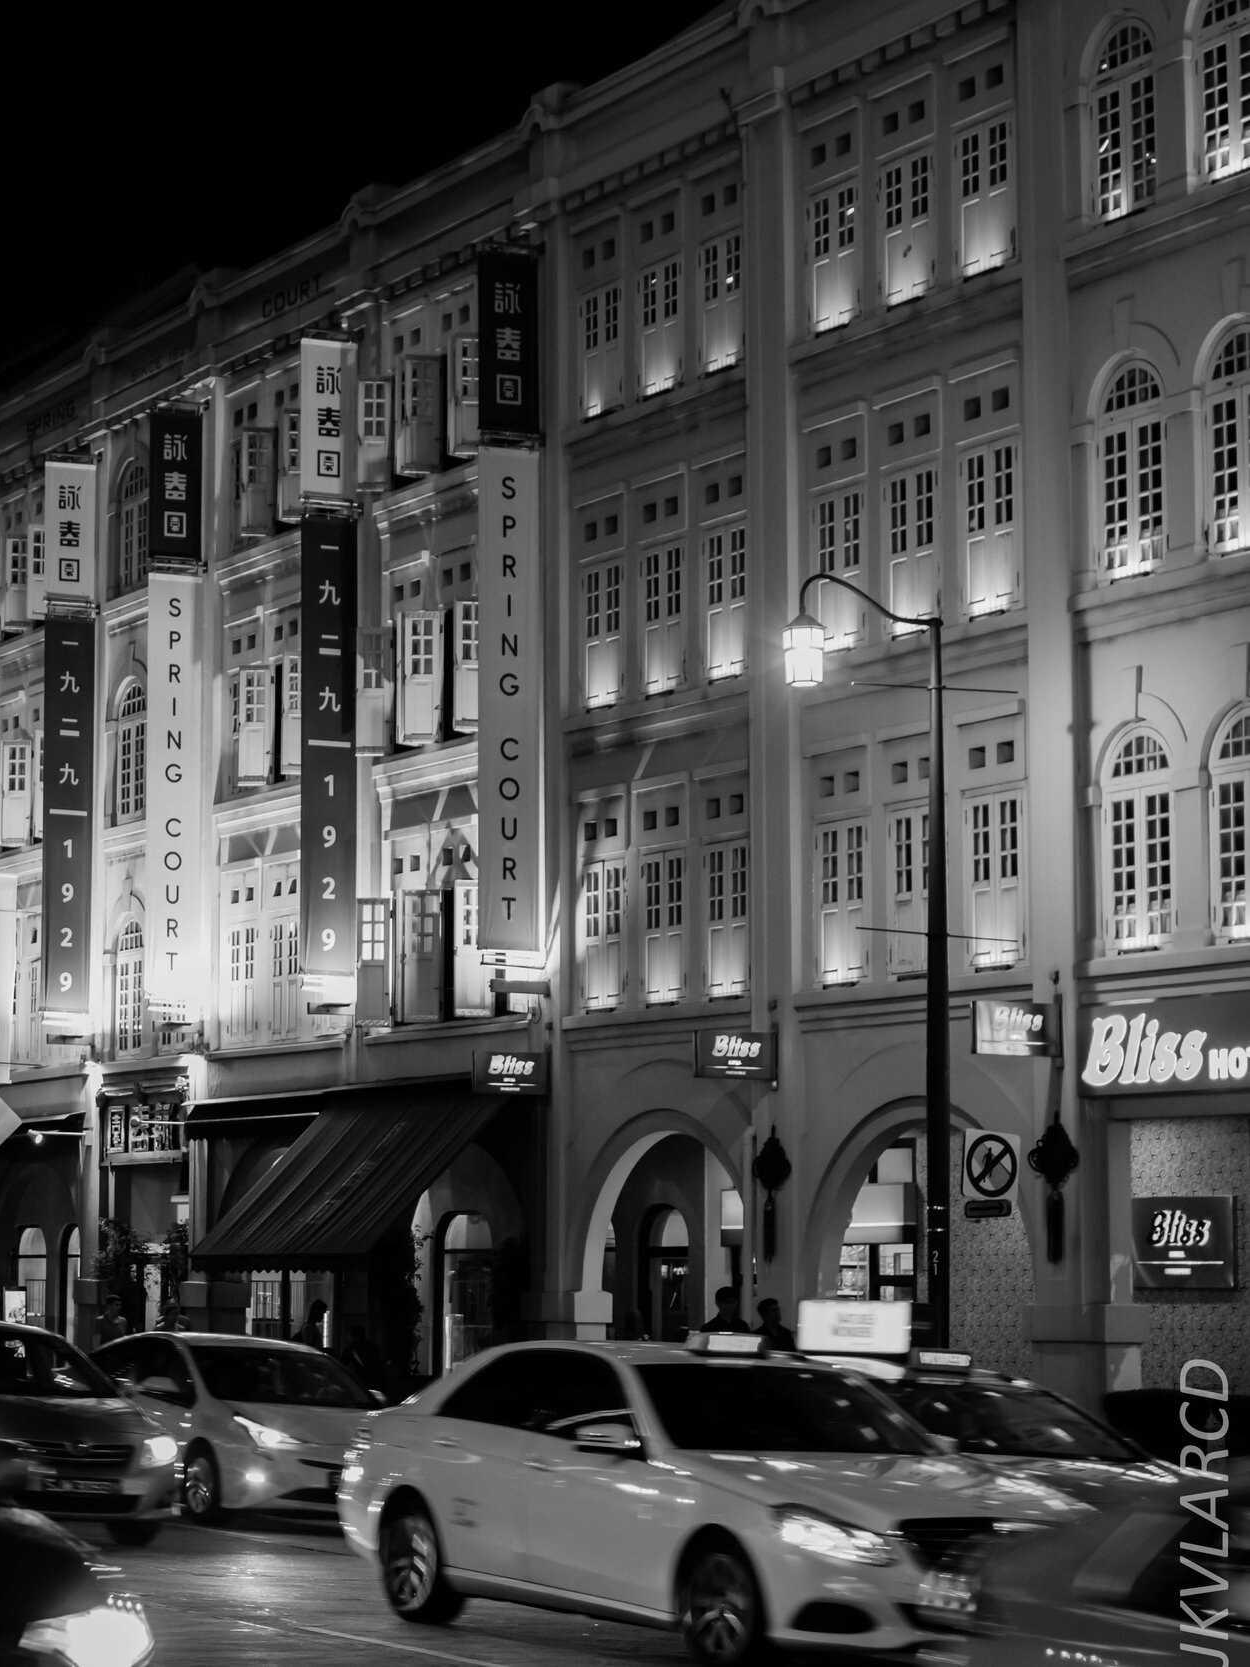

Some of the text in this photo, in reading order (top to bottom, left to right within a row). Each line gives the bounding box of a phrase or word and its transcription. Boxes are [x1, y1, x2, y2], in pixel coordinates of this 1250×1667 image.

[261, 273, 325, 319] COURT
[26, 400, 76, 438] SPRING
[499, 475, 521, 921] SPRING COURT
[318, 544, 342, 951] 一九二九 1929
[163, 597, 183, 972] SPRING COURT
[60, 640, 81, 992] 一九二九 1929
[993, 1006, 1044, 1032] Bliss
[487, 1054, 535, 1076] Bliss
[711, 1034, 762, 1058] Bliss
[1081, 1012, 1250, 1087] Bliss HO
[1148, 1208, 1212, 1248] Bliss
[932, 1249, 939, 1276] 21
